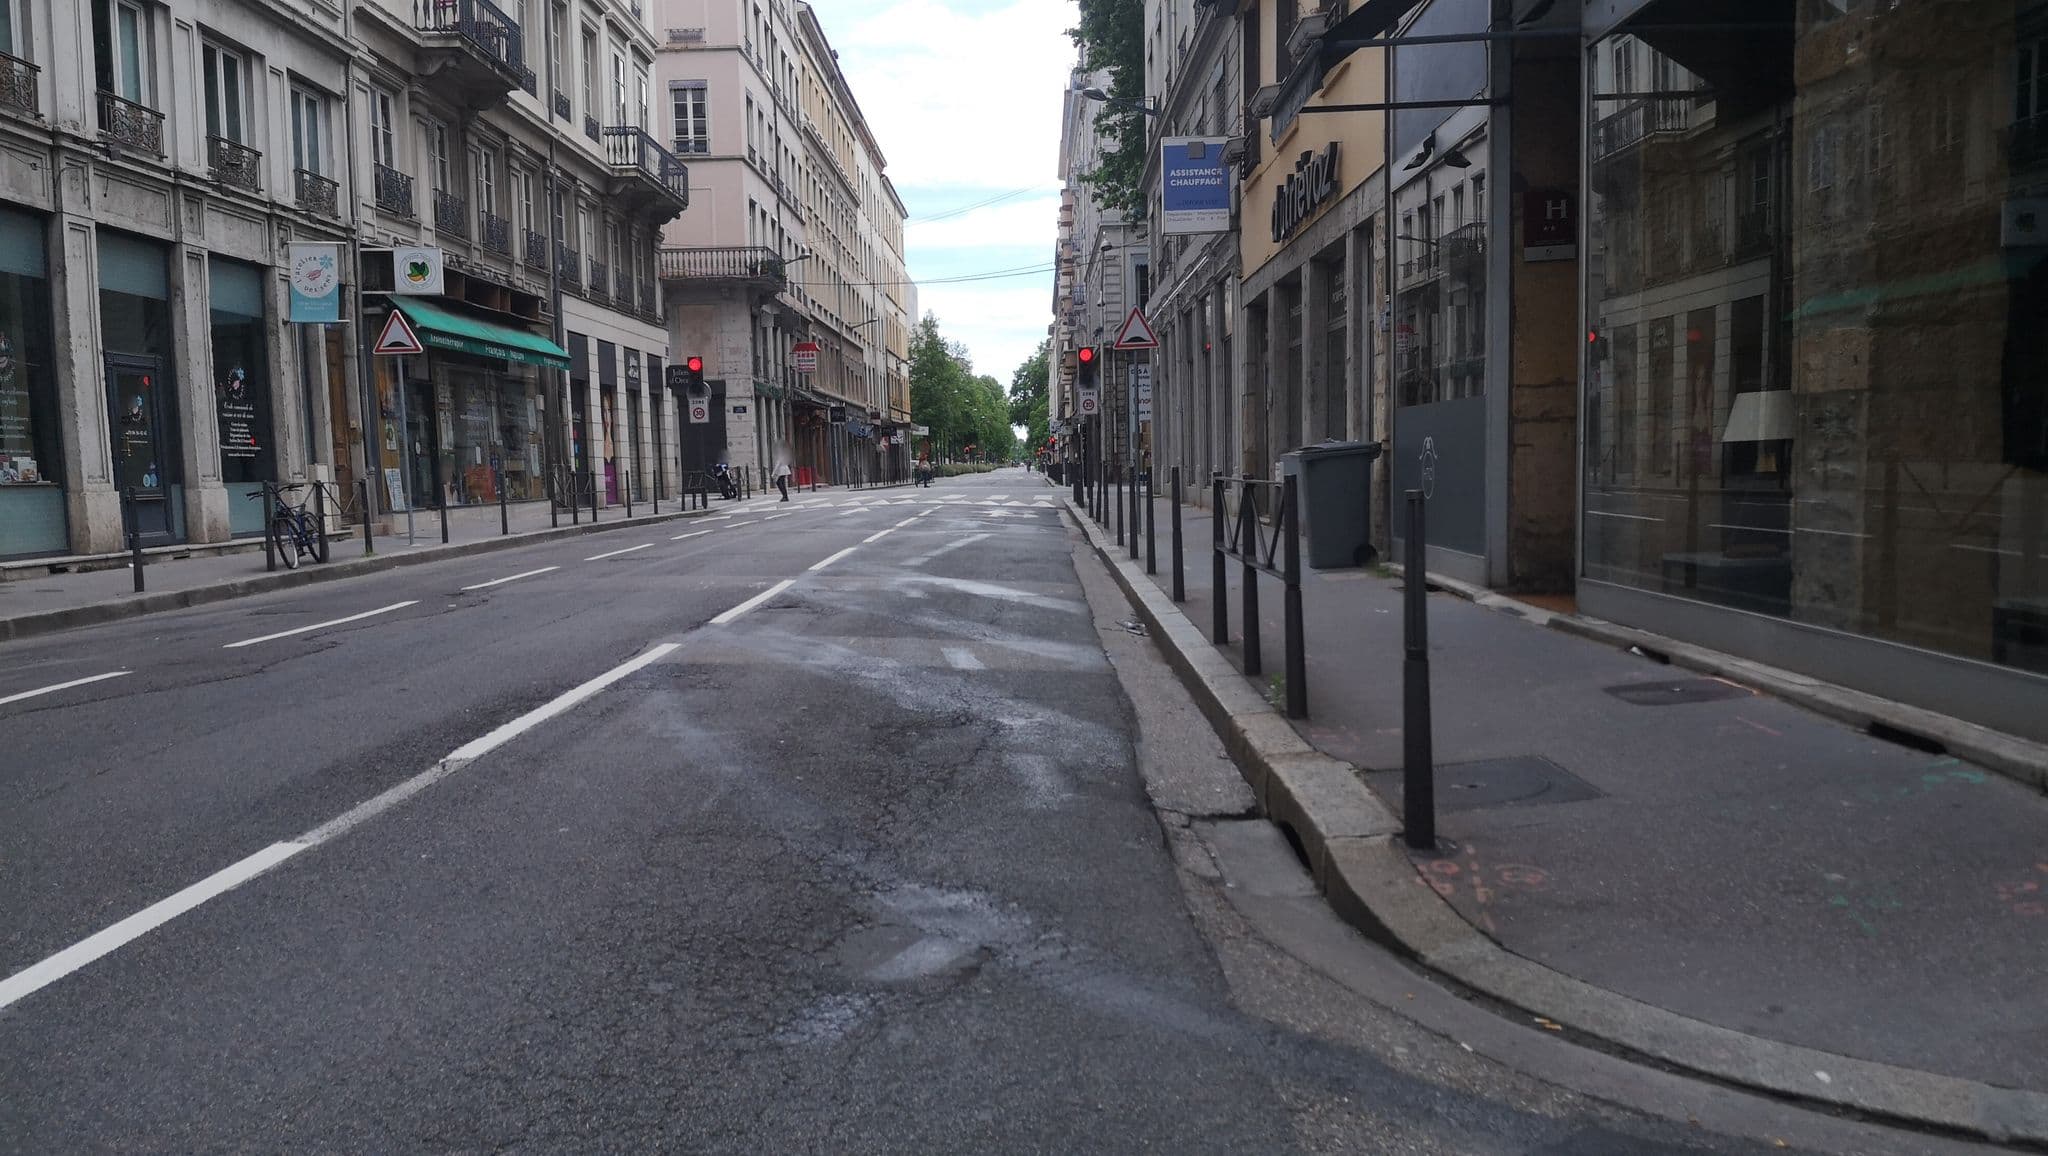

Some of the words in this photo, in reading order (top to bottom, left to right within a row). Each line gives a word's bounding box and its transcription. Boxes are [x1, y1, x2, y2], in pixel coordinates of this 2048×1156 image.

[1170, 168, 1223, 178] ASSISTANCE
[1170, 178, 1223, 187] CHAUFFAGE
[1545, 200, 1568, 219] H
